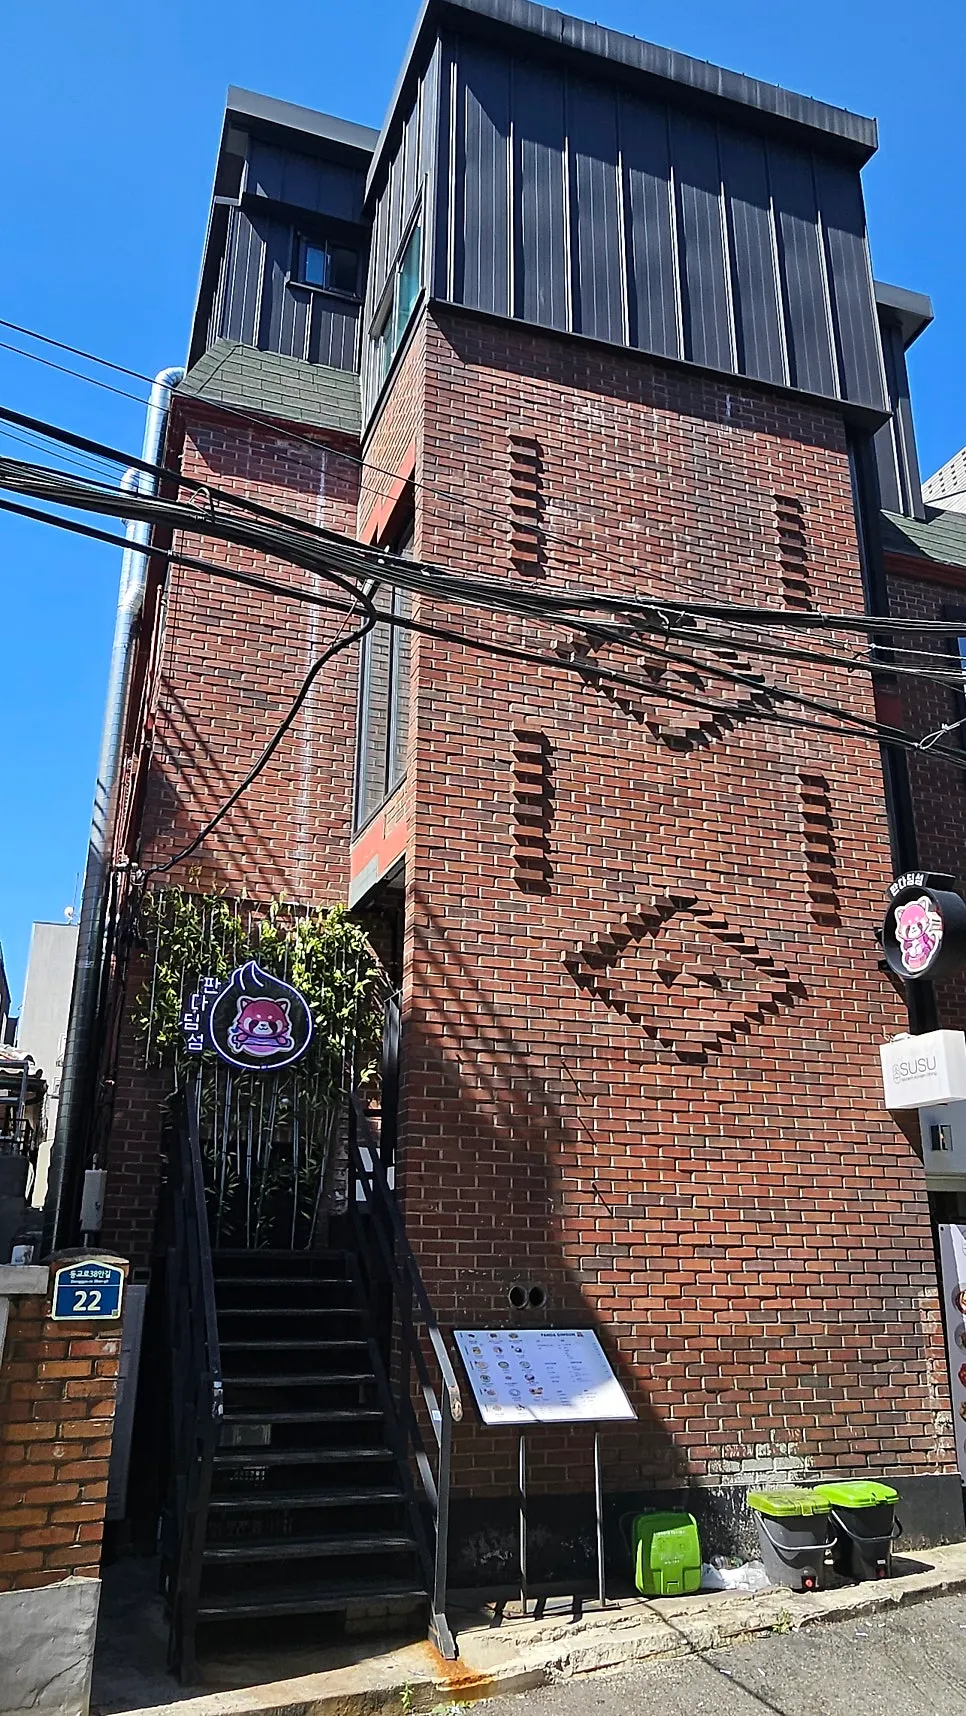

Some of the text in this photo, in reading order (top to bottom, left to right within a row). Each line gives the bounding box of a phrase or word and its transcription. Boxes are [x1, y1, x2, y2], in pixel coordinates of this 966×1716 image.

[890, 872, 924, 897] 판다딤섬
[183, 976, 222, 1051] 판다딤섬
[899, 1056, 937, 1077] SUSU
[69, 1270, 112, 1279] 동교로38안길
[72, 1290, 102, 1312] 22
